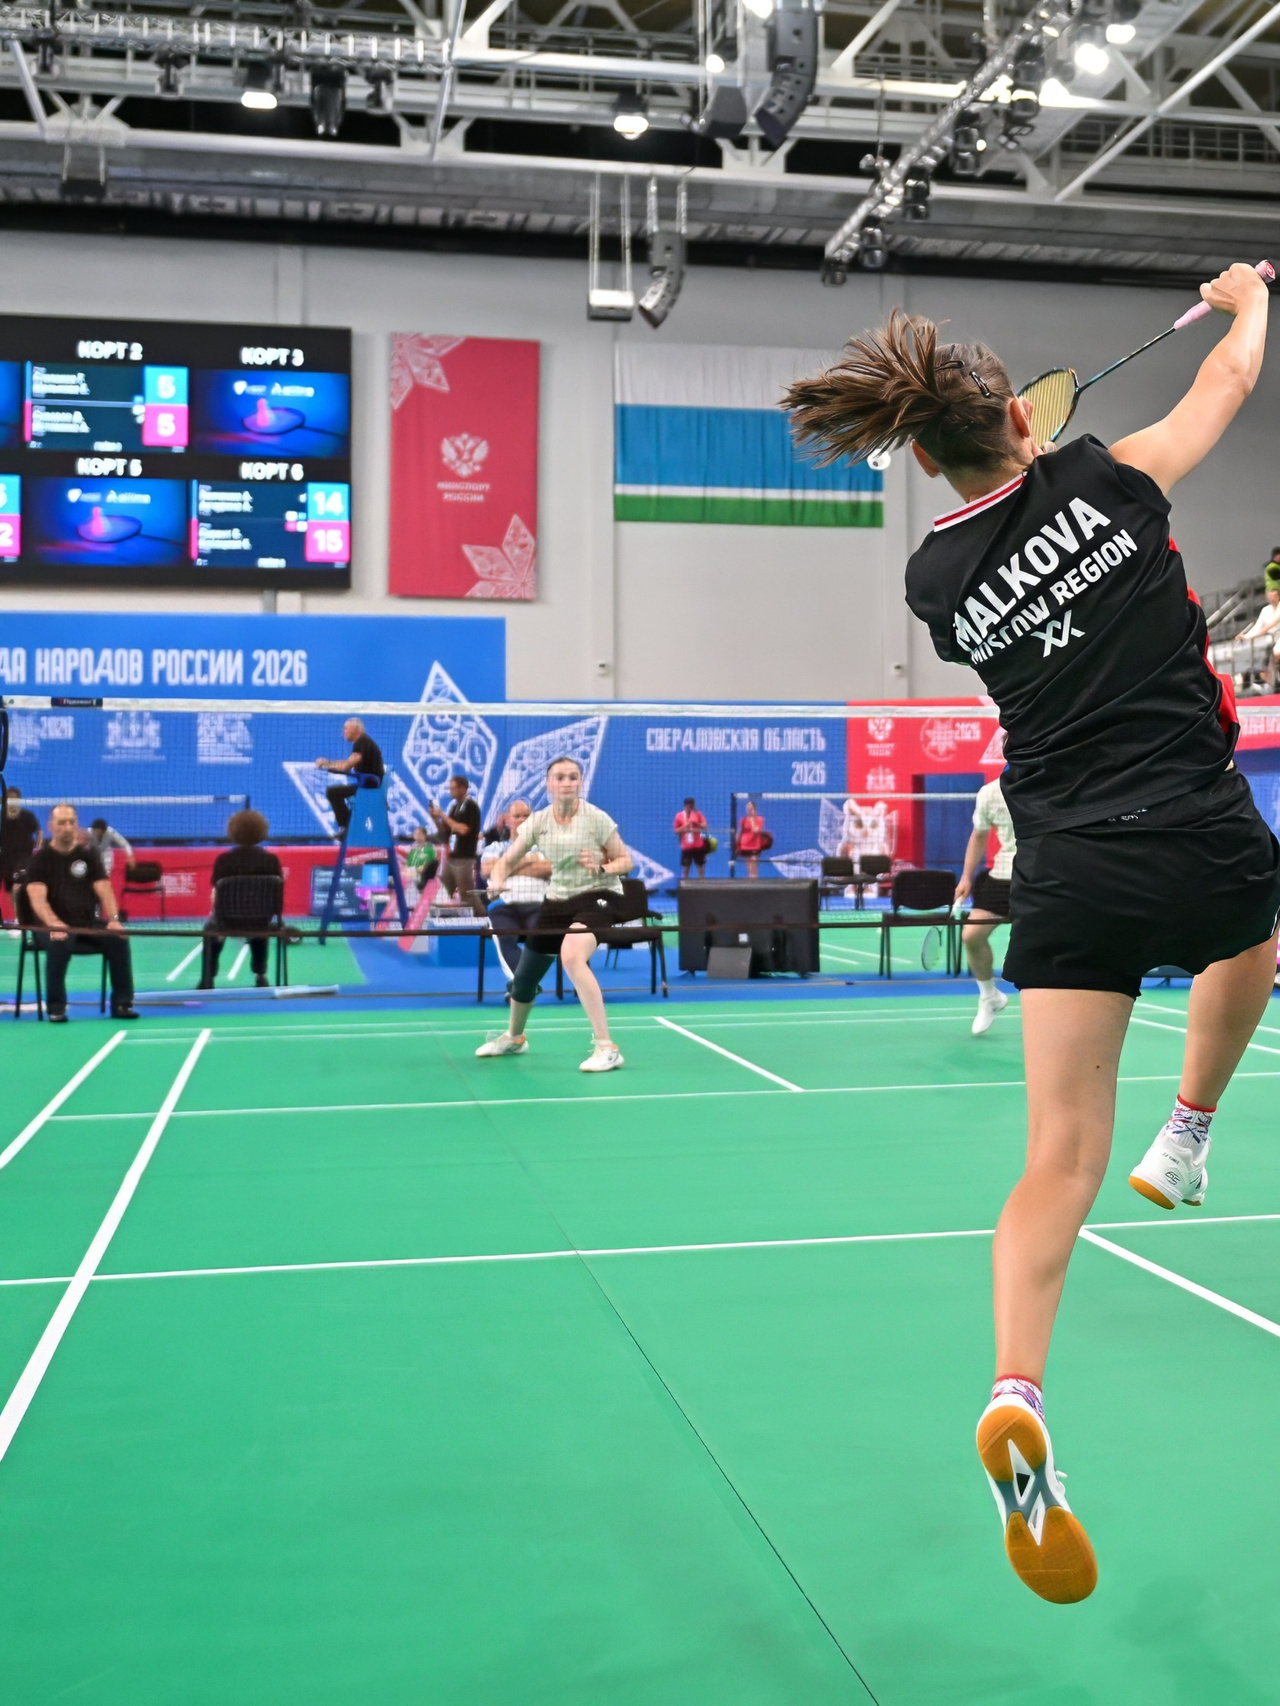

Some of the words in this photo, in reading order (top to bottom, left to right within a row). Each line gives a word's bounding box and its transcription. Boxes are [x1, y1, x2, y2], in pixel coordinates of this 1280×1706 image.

[77, 340, 128, 360] КОРТ
[130, 342, 144, 360] 2
[240, 346, 290, 365] КОРТ
[157, 375, 177, 399] 5
[157, 413, 176, 438] 5
[76, 457, 128, 475] КОРТ
[240, 462, 289, 480] КОРТ
[291, 463, 304, 481] 6
[313, 490, 345, 516] 14
[313, 528, 344, 554] 15
[953, 497, 1112, 652] MALKOVA
[1049, 528, 1139, 606] REGION
[35, 648, 143, 685] НАРОДОВ
[152, 649, 243, 686] РОССИИ
[252, 649, 307, 686] 2026
[791, 761, 826, 786] 2026
